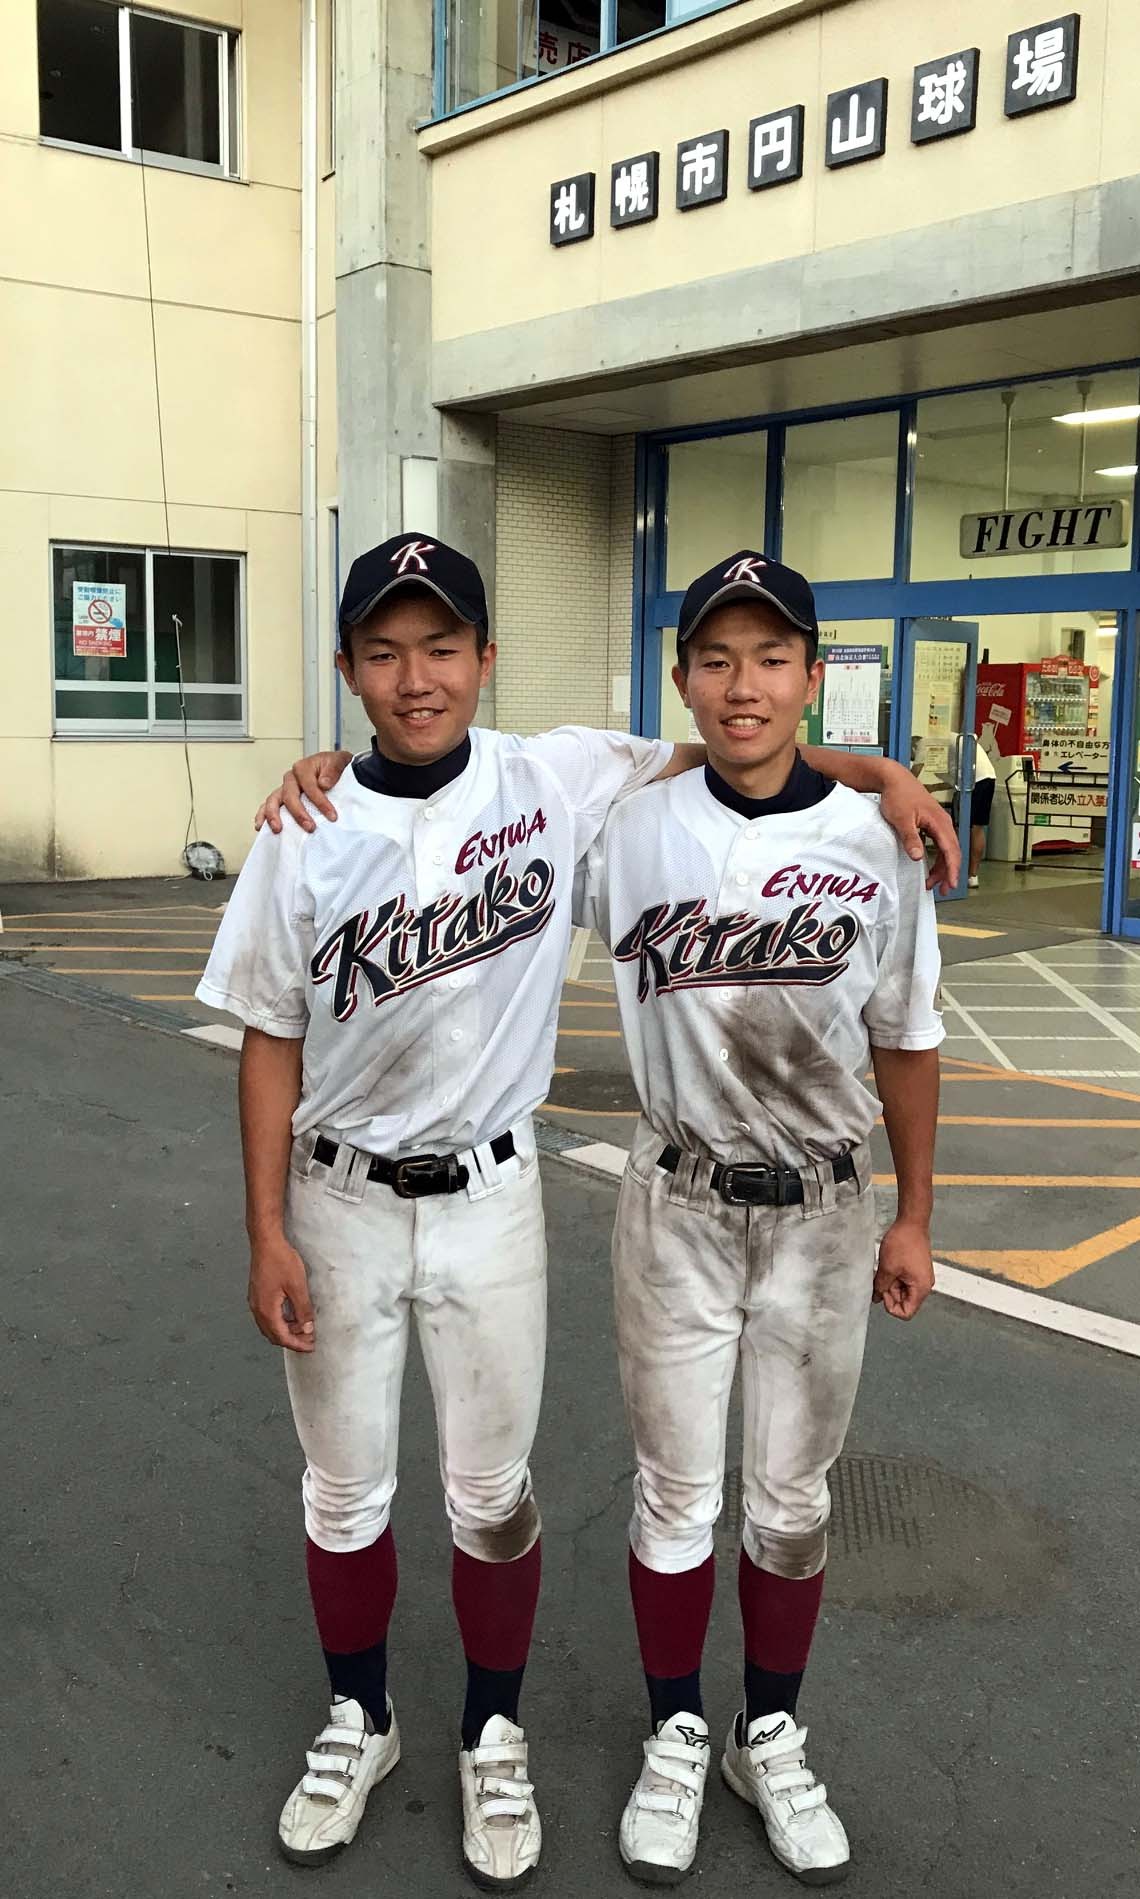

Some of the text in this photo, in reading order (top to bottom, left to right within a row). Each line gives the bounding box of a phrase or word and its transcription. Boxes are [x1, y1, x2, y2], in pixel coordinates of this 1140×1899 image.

[553, 26, 1066, 235] 札幌市円山球場
[972, 507, 1112, 553] FIGHT
[389, 540, 438, 575] K
[722, 557, 768, 583] K
[1030, 792, 1109, 808] 関係者以外立入禁
[455, 807, 547, 875] ENIWA
[761, 865, 880, 903] ENIWA
[310, 857, 555, 1022] Kitako
[612, 897, 860, 1004] Kitako
